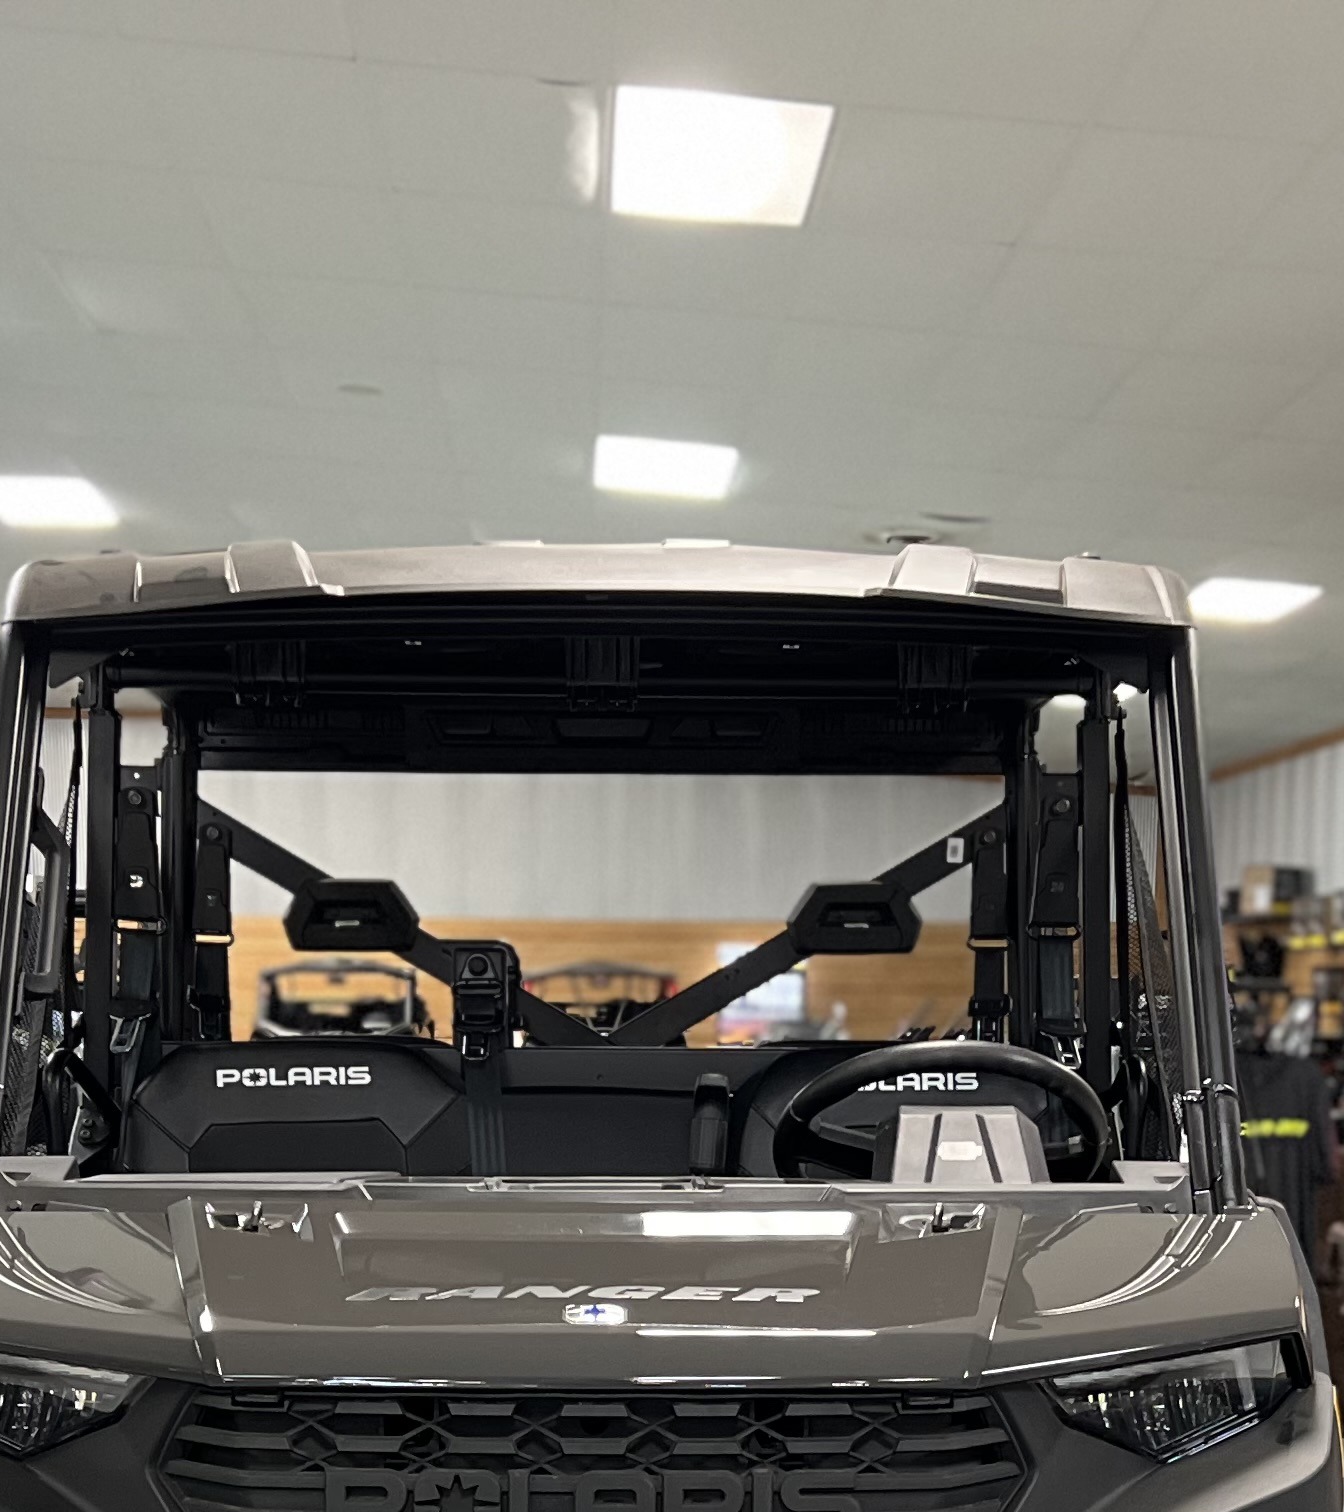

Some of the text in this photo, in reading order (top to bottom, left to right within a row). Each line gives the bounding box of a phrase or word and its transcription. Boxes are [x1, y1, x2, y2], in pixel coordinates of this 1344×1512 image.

[216, 1066, 372, 1088] POLARIS
[858, 1072, 979, 1091] LARIS
[345, 1285, 821, 1303] RANGER
